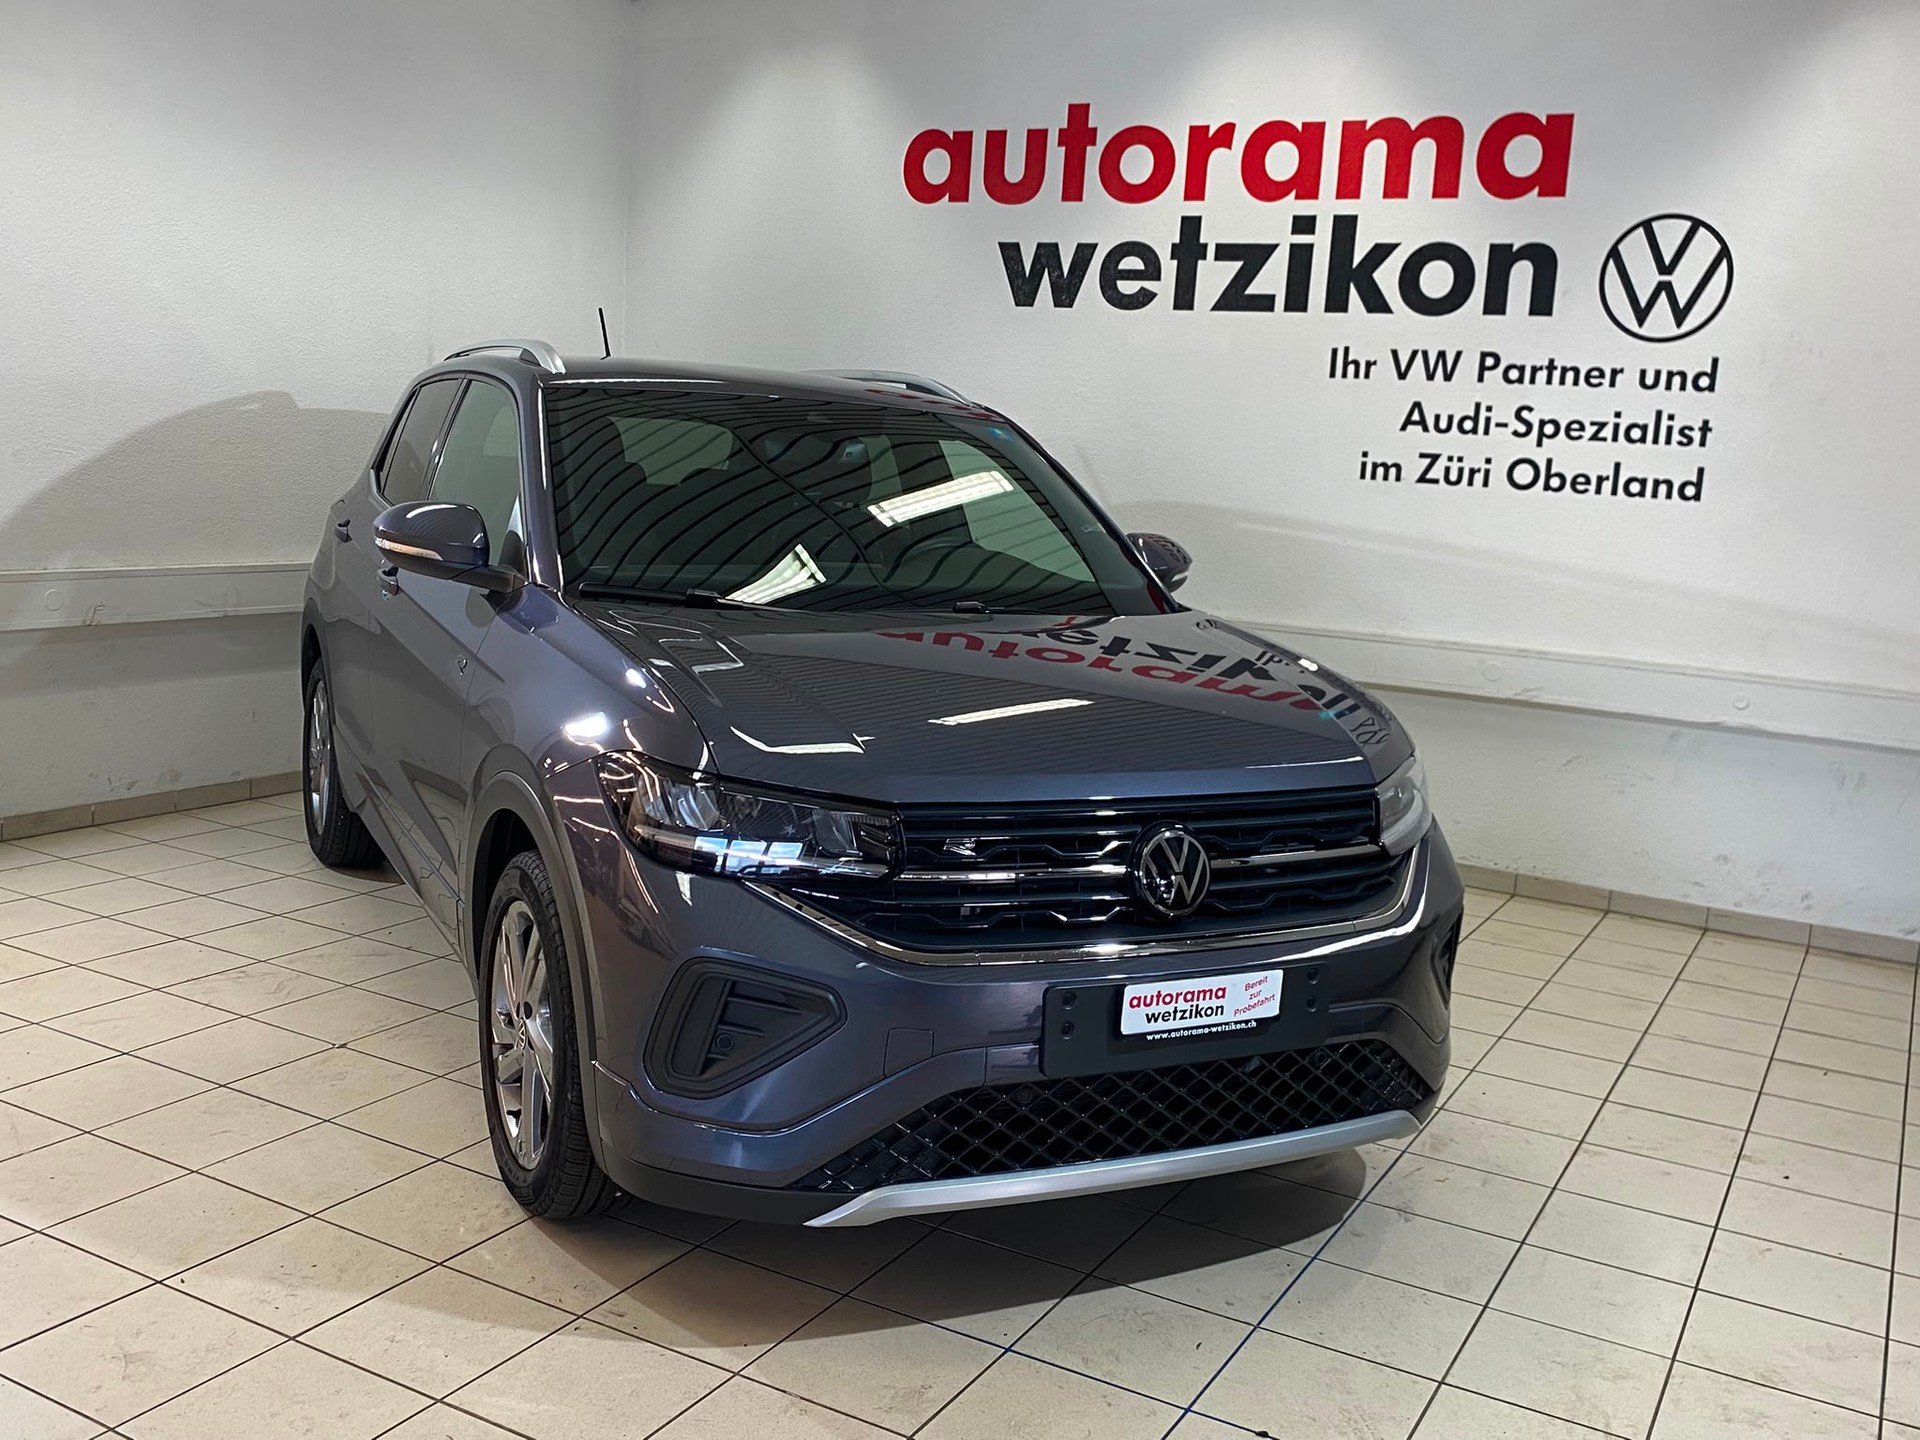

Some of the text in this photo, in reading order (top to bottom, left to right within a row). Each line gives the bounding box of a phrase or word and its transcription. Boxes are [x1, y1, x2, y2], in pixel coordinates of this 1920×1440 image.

[903, 103, 1574, 205] autorama
[997, 214, 1559, 317] wetzikon
[1328, 346, 1720, 393] Ihr VW Partner und
[1399, 400, 1713, 448] Audi-Spezialist
[1359, 450, 1705, 502] im Züri Oberland
[1244, 976, 1268, 992] Bereit
[1249, 989, 1262, 1000] zur
[1129, 986, 1227, 1009] autorama
[1233, 994, 1276, 1017] Probefahrt
[1145, 1004, 1225, 1024] wetzikon
[1146, 1020, 1257, 1041] www.autorama-wetzikon.ch
